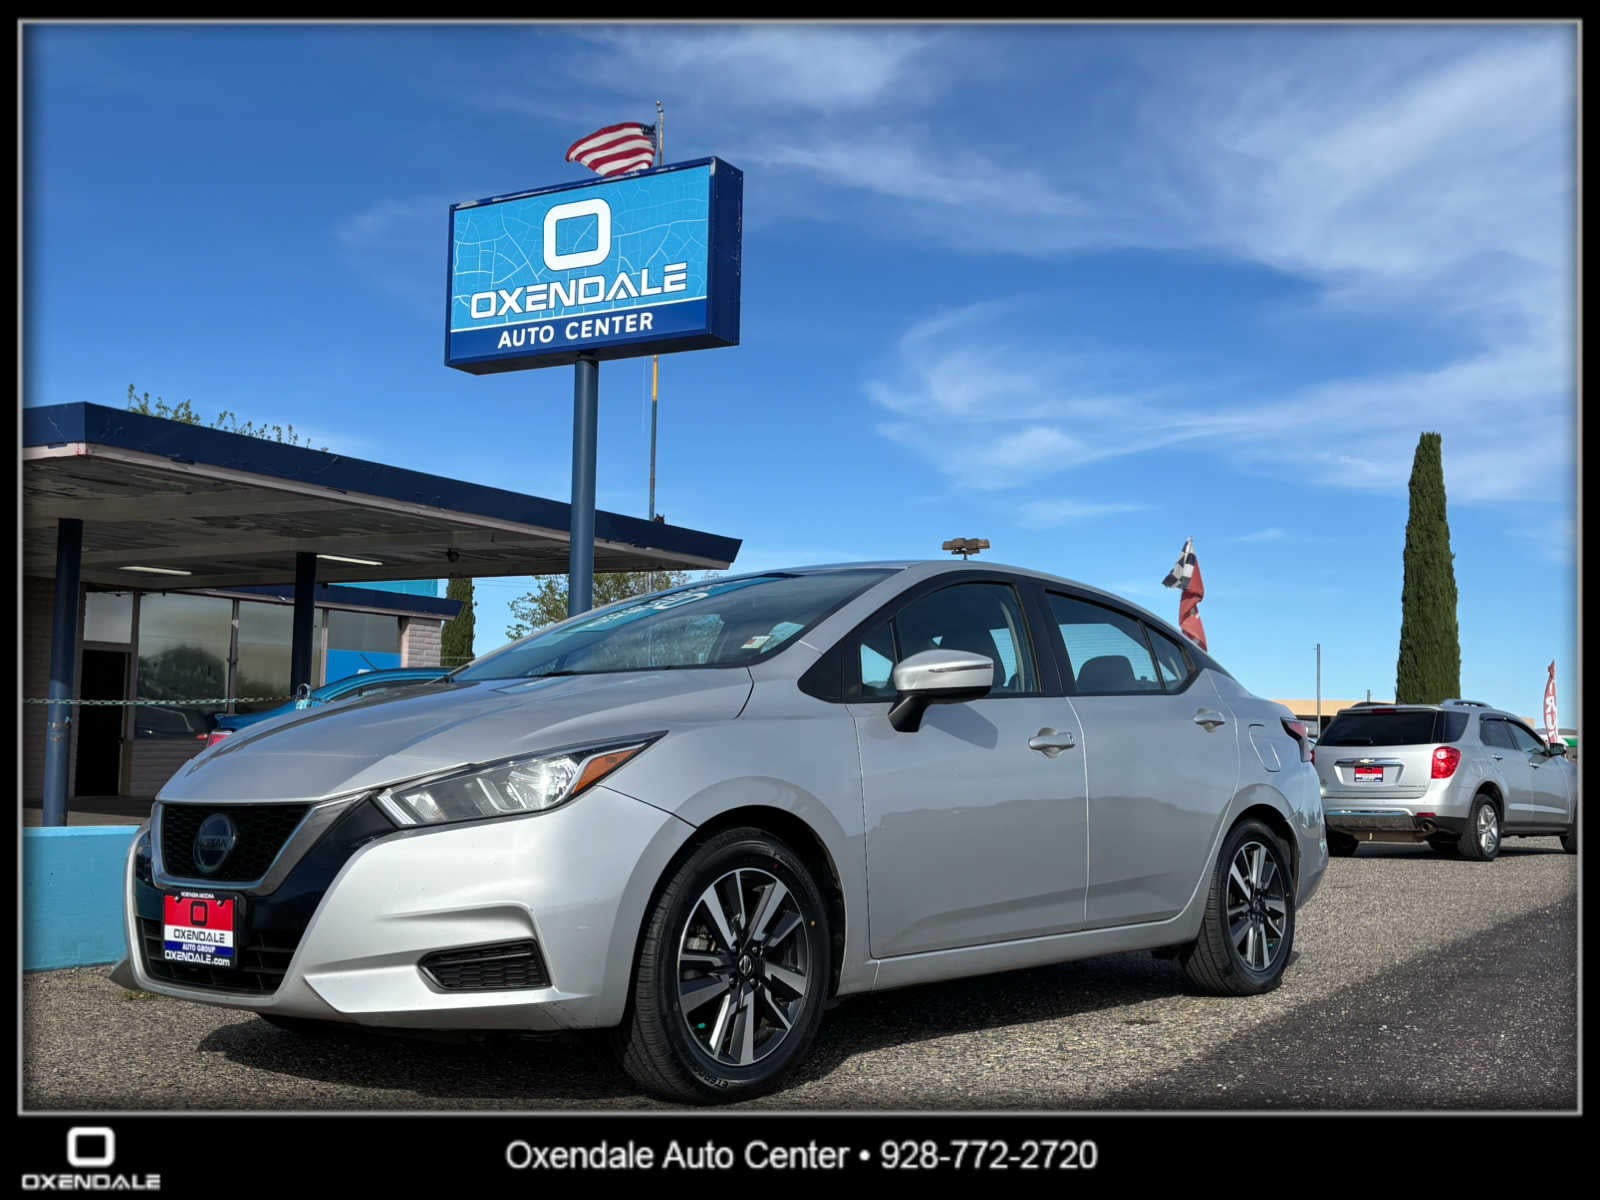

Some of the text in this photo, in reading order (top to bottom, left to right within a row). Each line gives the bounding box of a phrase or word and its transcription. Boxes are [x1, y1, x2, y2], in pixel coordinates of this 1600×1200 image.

[470, 262, 688, 319] OXENDALE
[497, 312, 653, 349] AUTO CENTER
[174, 929, 225, 943] OXENDALE
[183, 943, 216, 953] AUTO GROUP
[165, 950, 230, 966] OXENDALE.com
